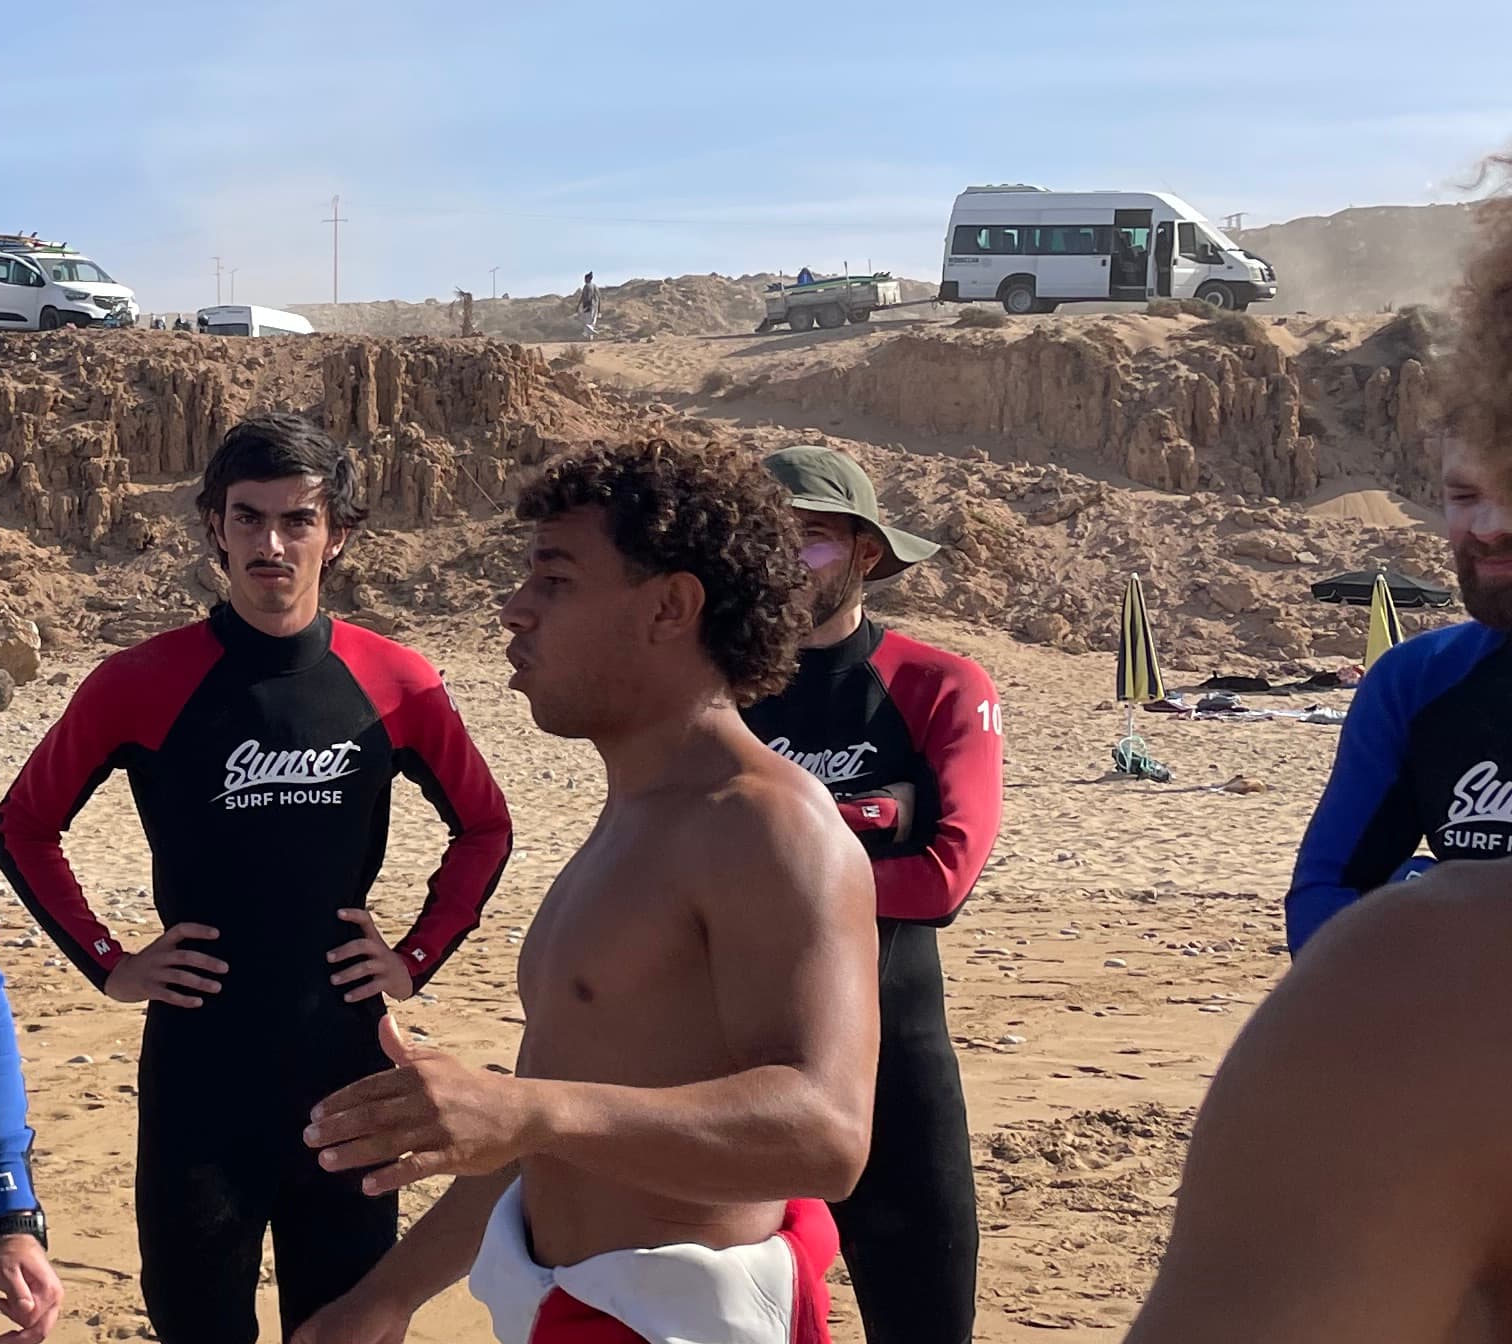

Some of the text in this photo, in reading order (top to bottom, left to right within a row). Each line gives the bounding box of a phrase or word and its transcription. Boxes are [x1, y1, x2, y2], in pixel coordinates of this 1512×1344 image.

[977, 700, 1003, 736] 10
[224, 739, 361, 790] Sunset
[225, 790, 343, 810] SURF HOUSE
[1444, 830, 1503, 850] SURF
